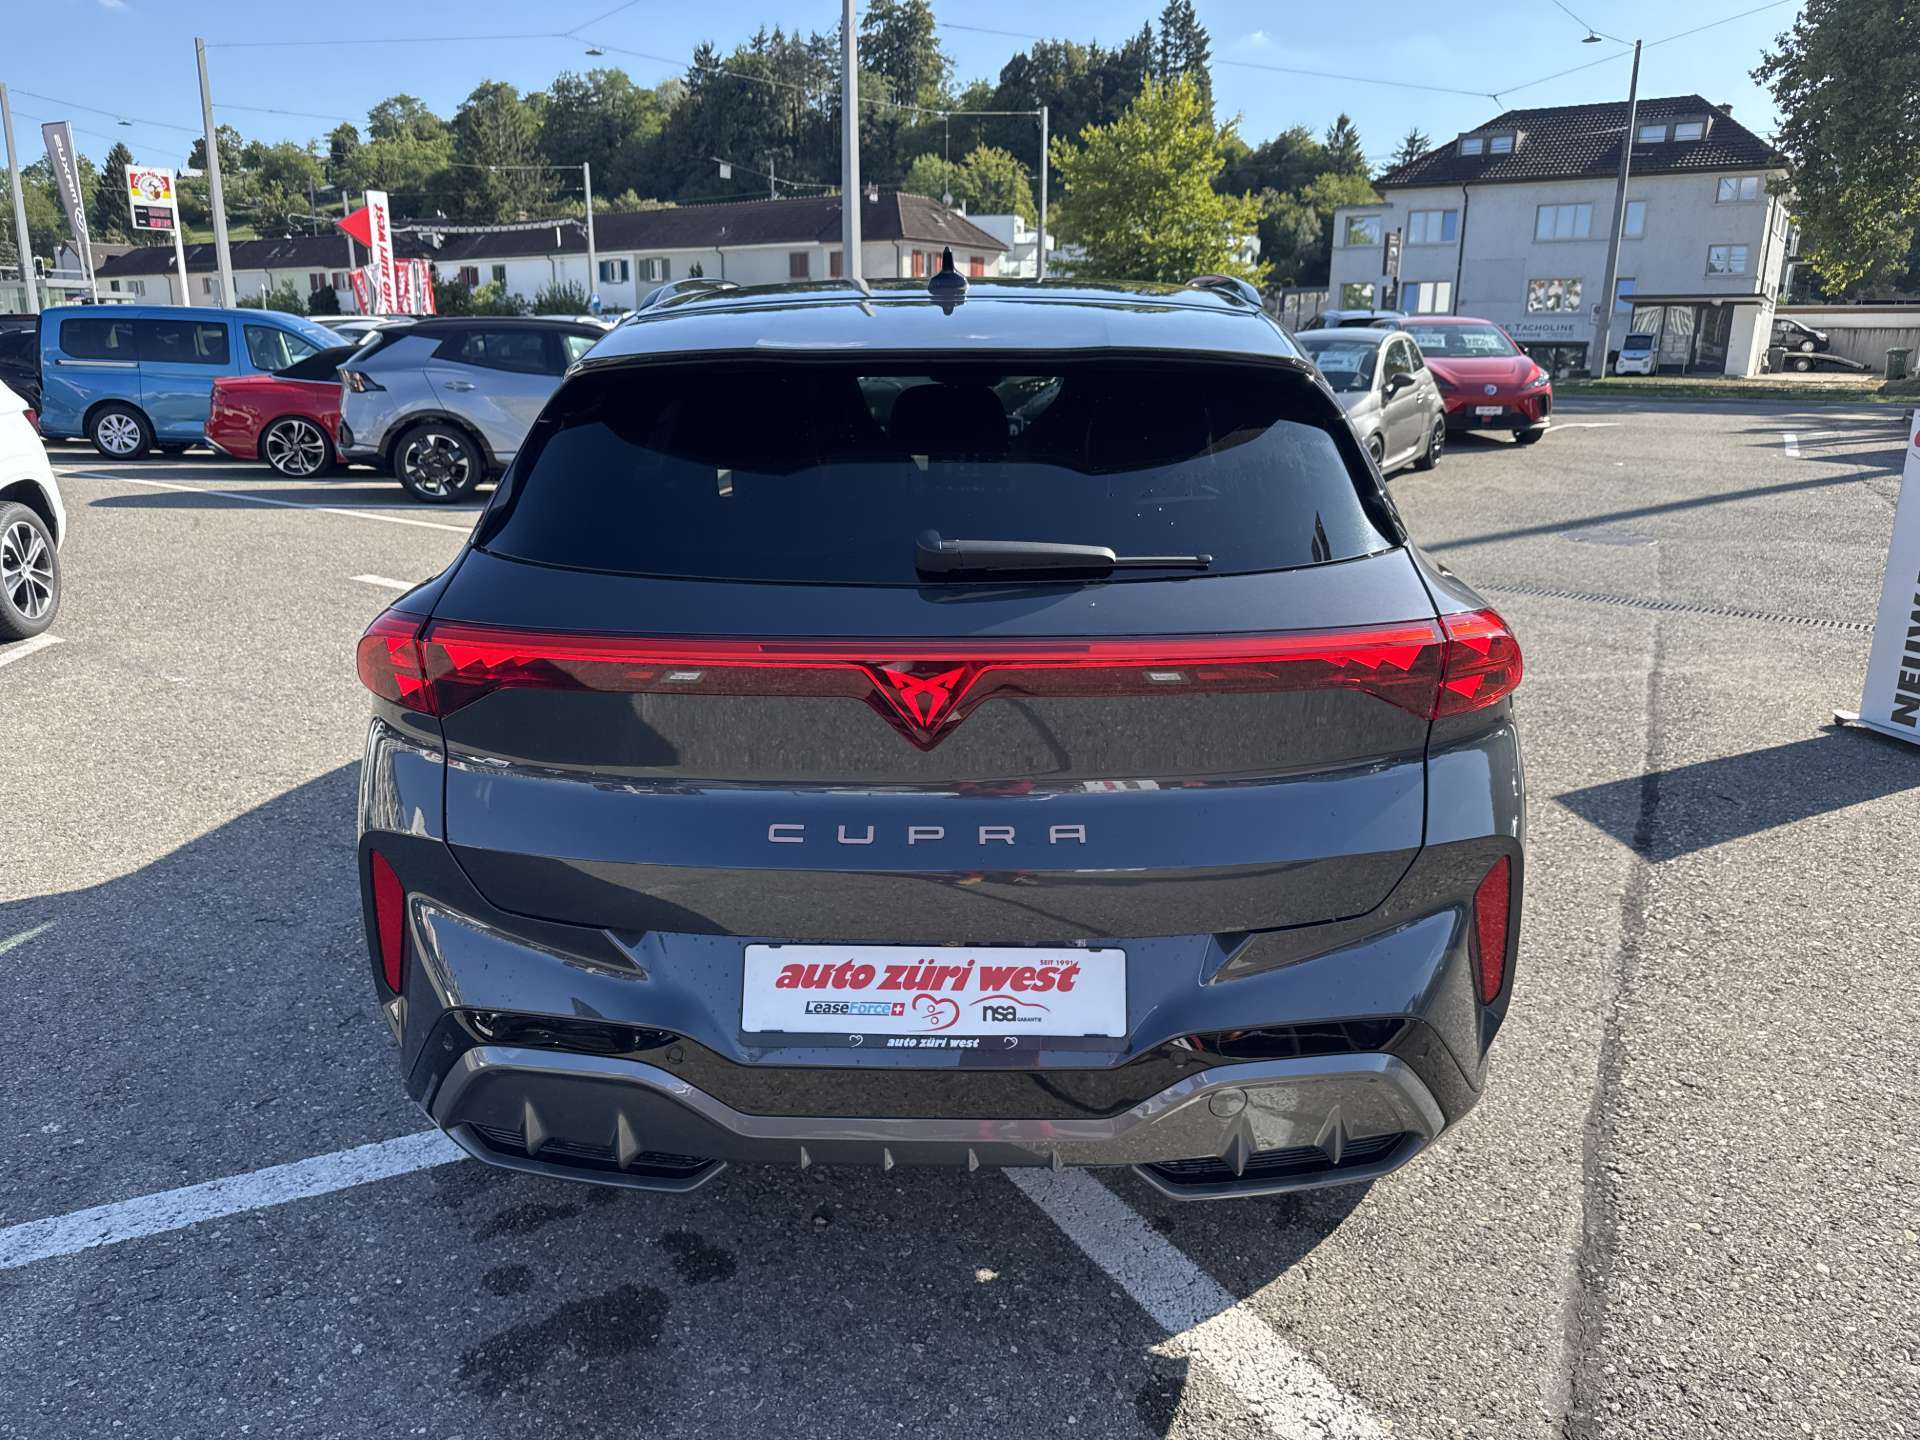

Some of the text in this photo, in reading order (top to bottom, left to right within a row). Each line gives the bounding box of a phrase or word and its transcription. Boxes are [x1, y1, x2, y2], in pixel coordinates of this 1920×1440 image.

[768, 824, 1087, 845] CUPRA
[775, 958, 1081, 992] auto züri west
[804, 1000, 891, 1015] LeaseForce
[982, 1005, 1017, 1022] nsa
[886, 1036, 980, 1048] auto züri west
